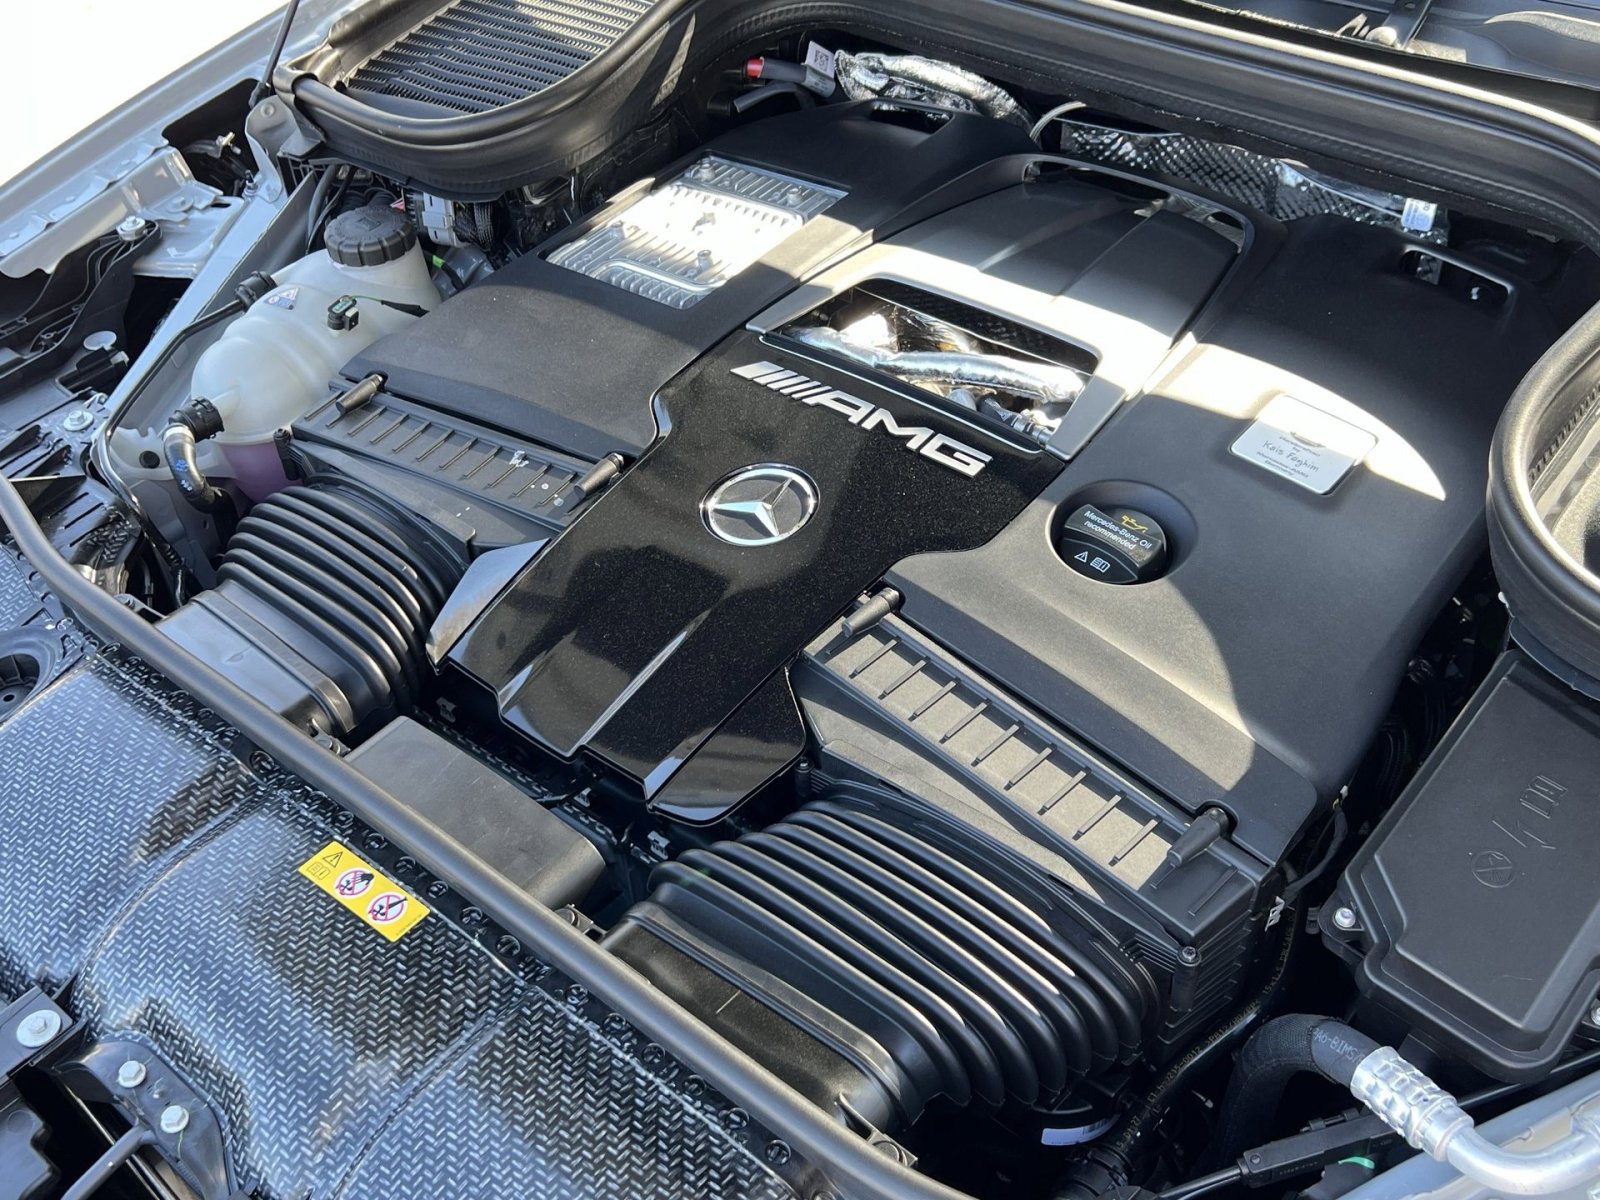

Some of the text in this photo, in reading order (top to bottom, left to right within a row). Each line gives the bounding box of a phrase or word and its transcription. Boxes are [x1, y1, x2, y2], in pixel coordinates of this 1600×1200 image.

[802, 390, 993, 478] AMG
[1084, 510, 1152, 549] Mercedes-Benz Oil
[1084, 520, 1137, 550] recommended
